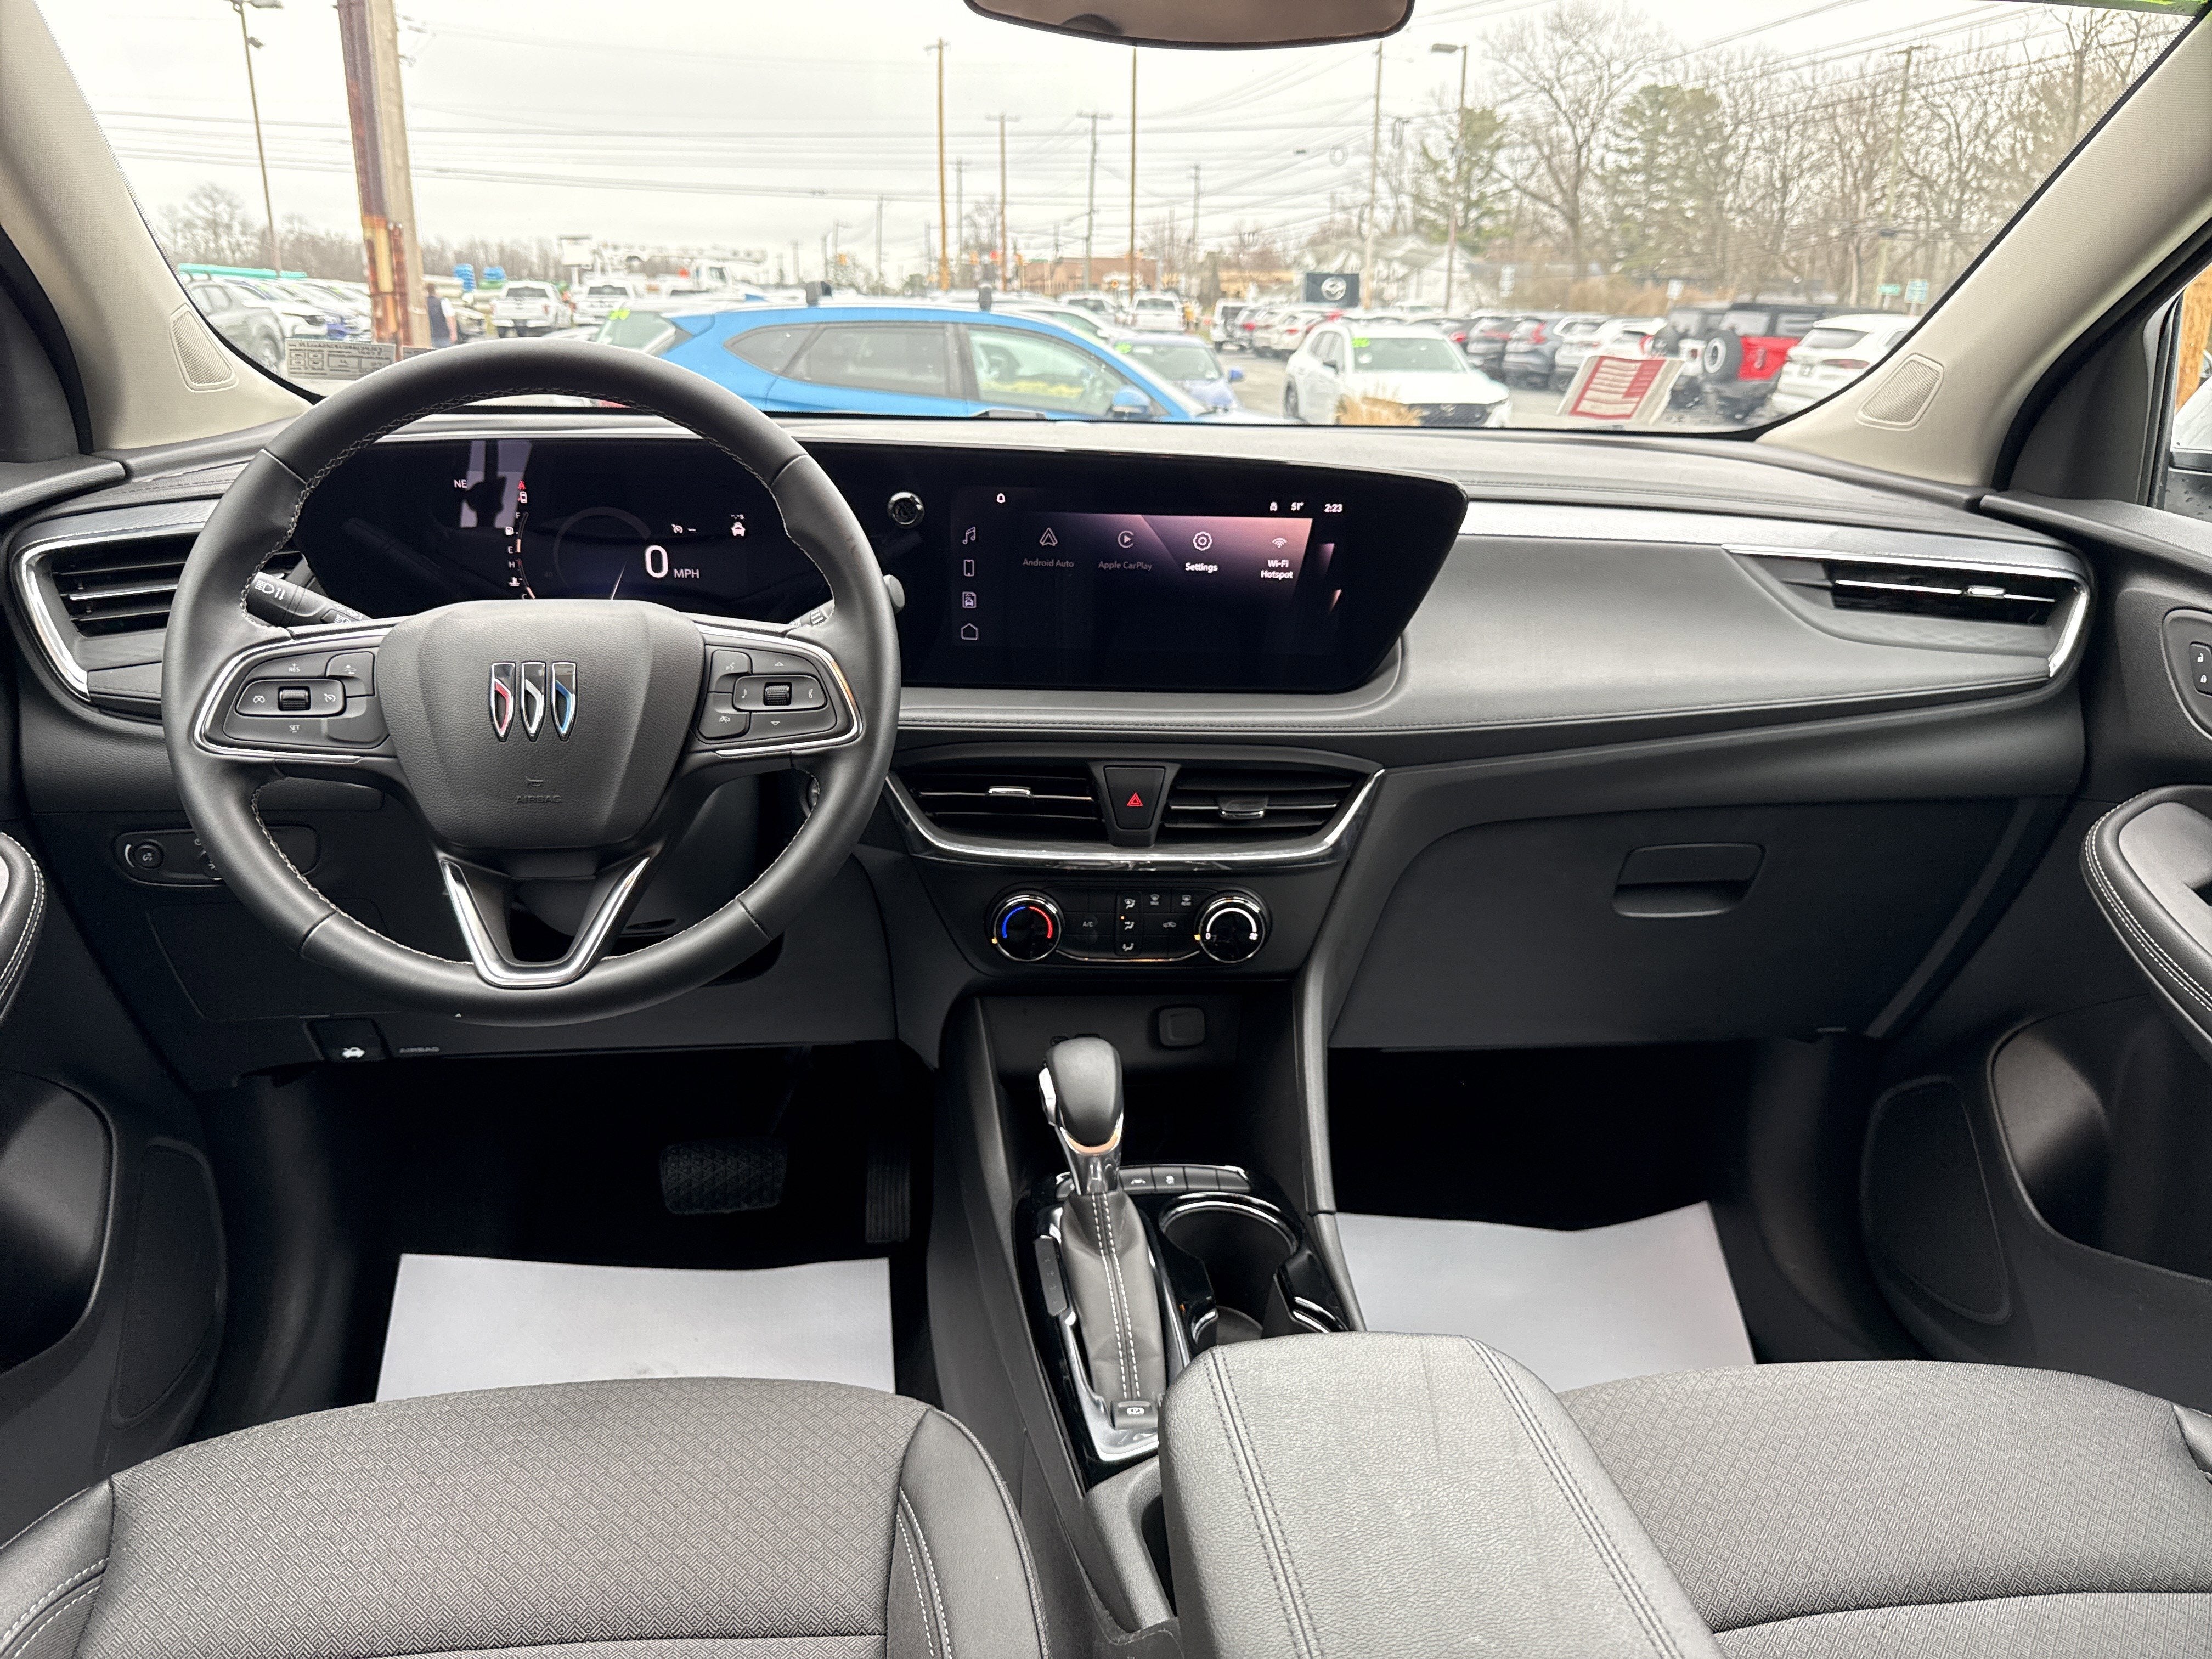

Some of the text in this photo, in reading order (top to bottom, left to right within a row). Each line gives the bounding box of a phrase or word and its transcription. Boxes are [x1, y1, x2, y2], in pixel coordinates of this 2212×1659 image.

[453, 479, 467, 488] NE
[1324, 503, 1344, 513] 2:23
[645, 544, 699, 579] 0 MPH
[1022, 558, 1075, 568] Android Auto
[1098, 561, 1153, 572] Apple CarPlay
[1267, 559, 1289, 568] Wi-Fi
[1184, 562, 1218, 573] Settings
[1260, 570, 1294, 580] Hotspot
[516, 795, 562, 804] AIRBAG
